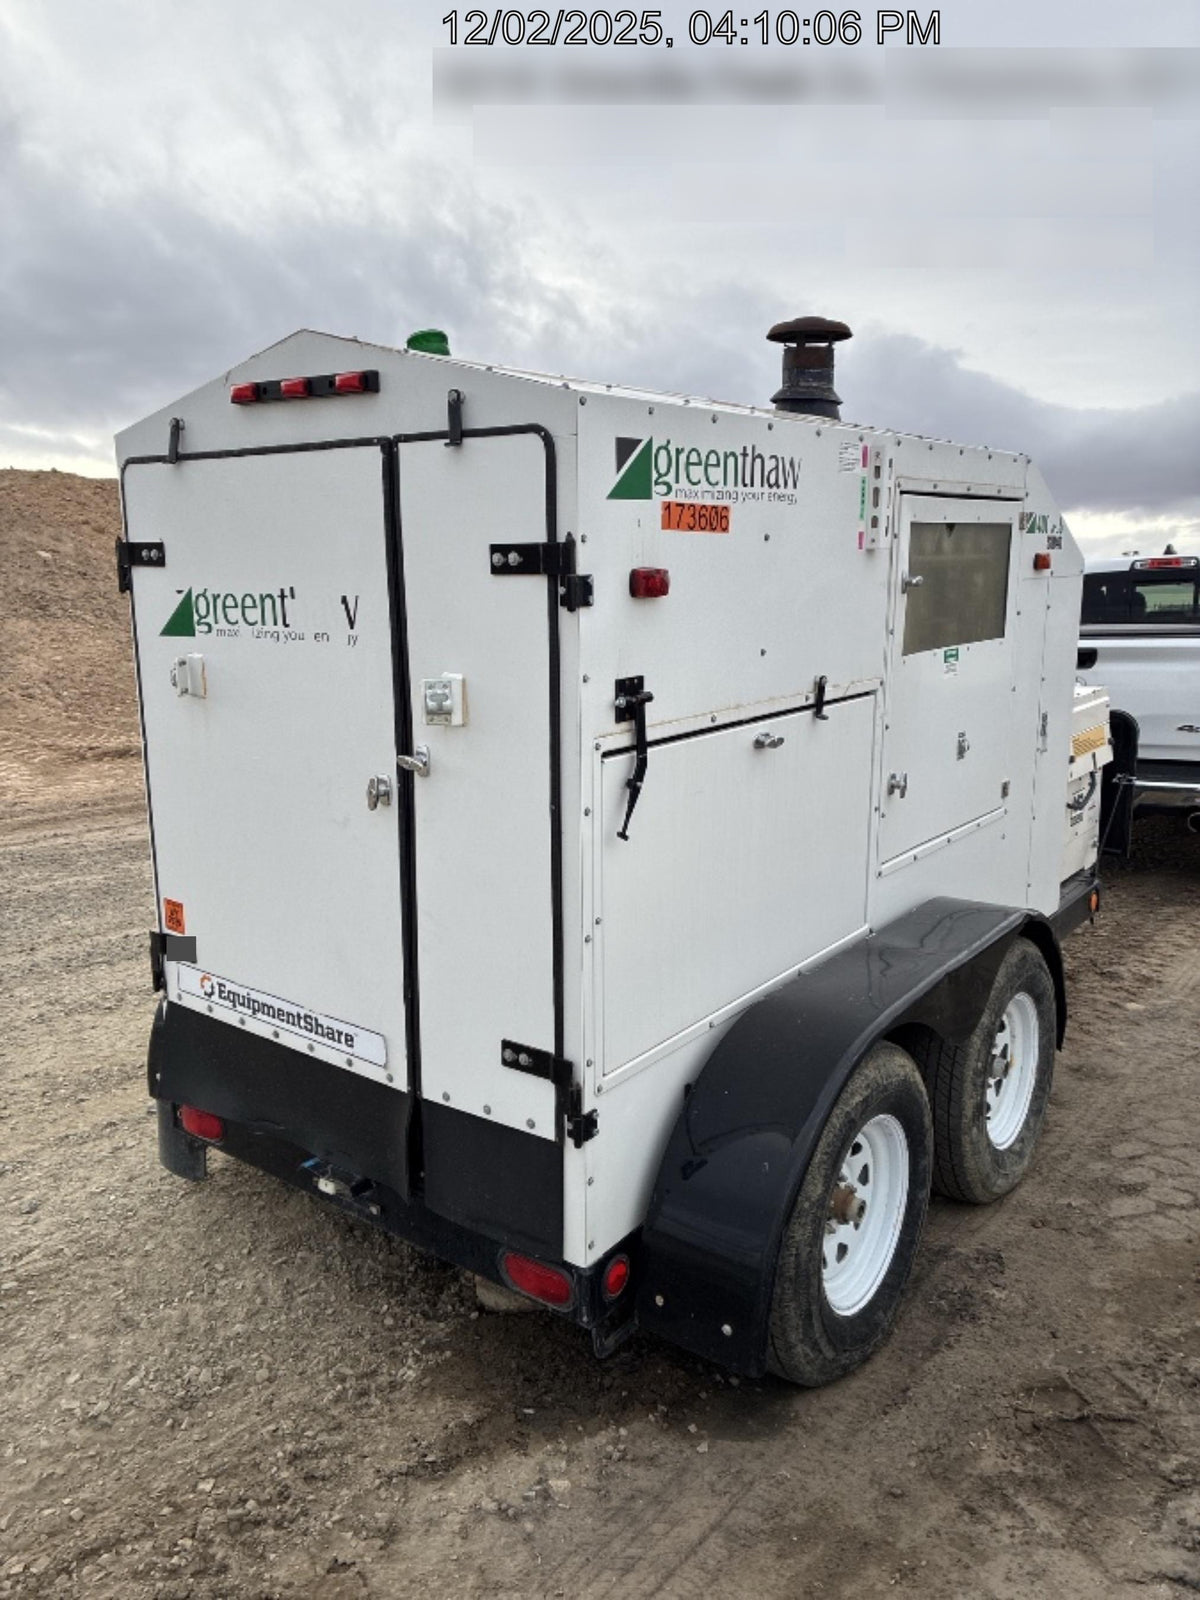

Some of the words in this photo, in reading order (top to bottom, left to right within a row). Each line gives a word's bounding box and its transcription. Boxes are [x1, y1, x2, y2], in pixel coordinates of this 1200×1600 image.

[654, 439, 802, 496] greenthaw
[664, 503, 730, 532] 173606
[282, 630, 305, 644] you
[217, 980, 355, 1048] EquipmentShare
